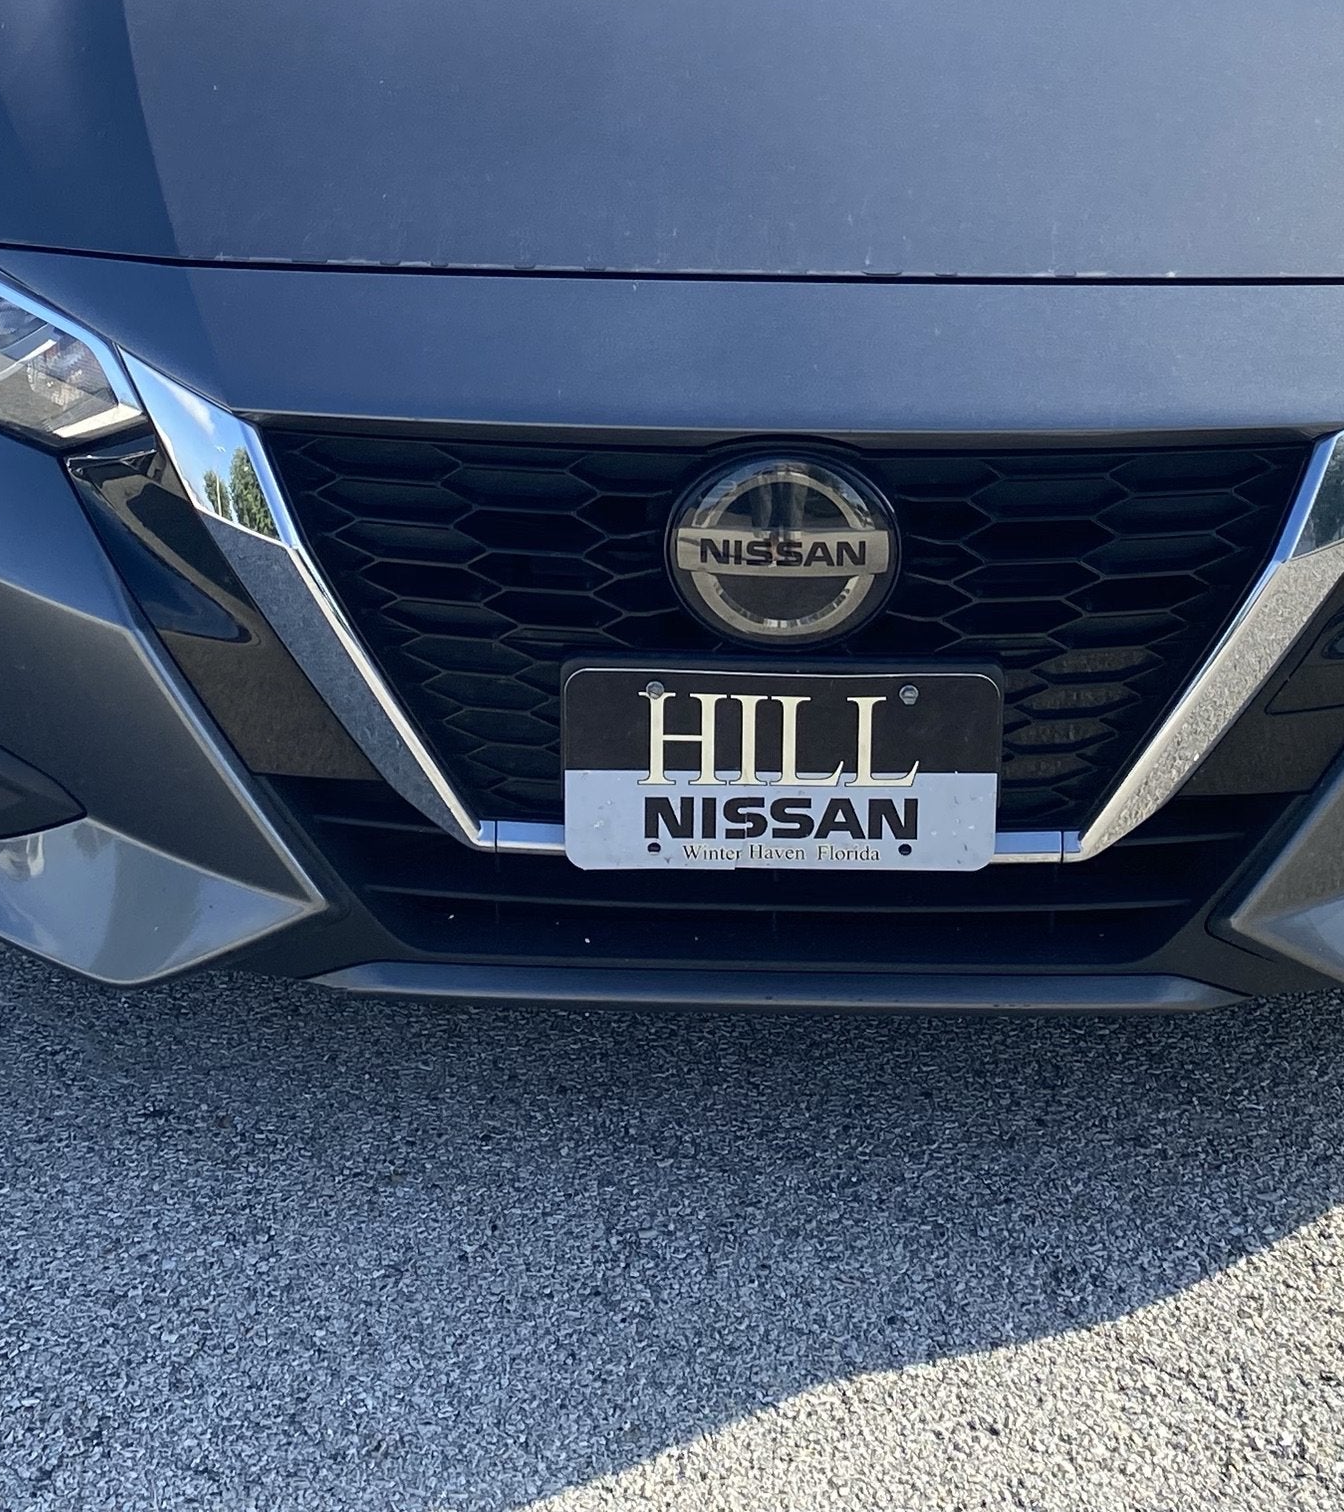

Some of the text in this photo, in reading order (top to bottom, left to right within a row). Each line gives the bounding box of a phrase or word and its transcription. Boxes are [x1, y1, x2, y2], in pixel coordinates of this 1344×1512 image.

[699, 538, 866, 567] NISSAN
[636, 690, 920, 788] HILL
[643, 796, 919, 840] NISSAN
[682, 844, 881, 862] Winter Haven Florida
